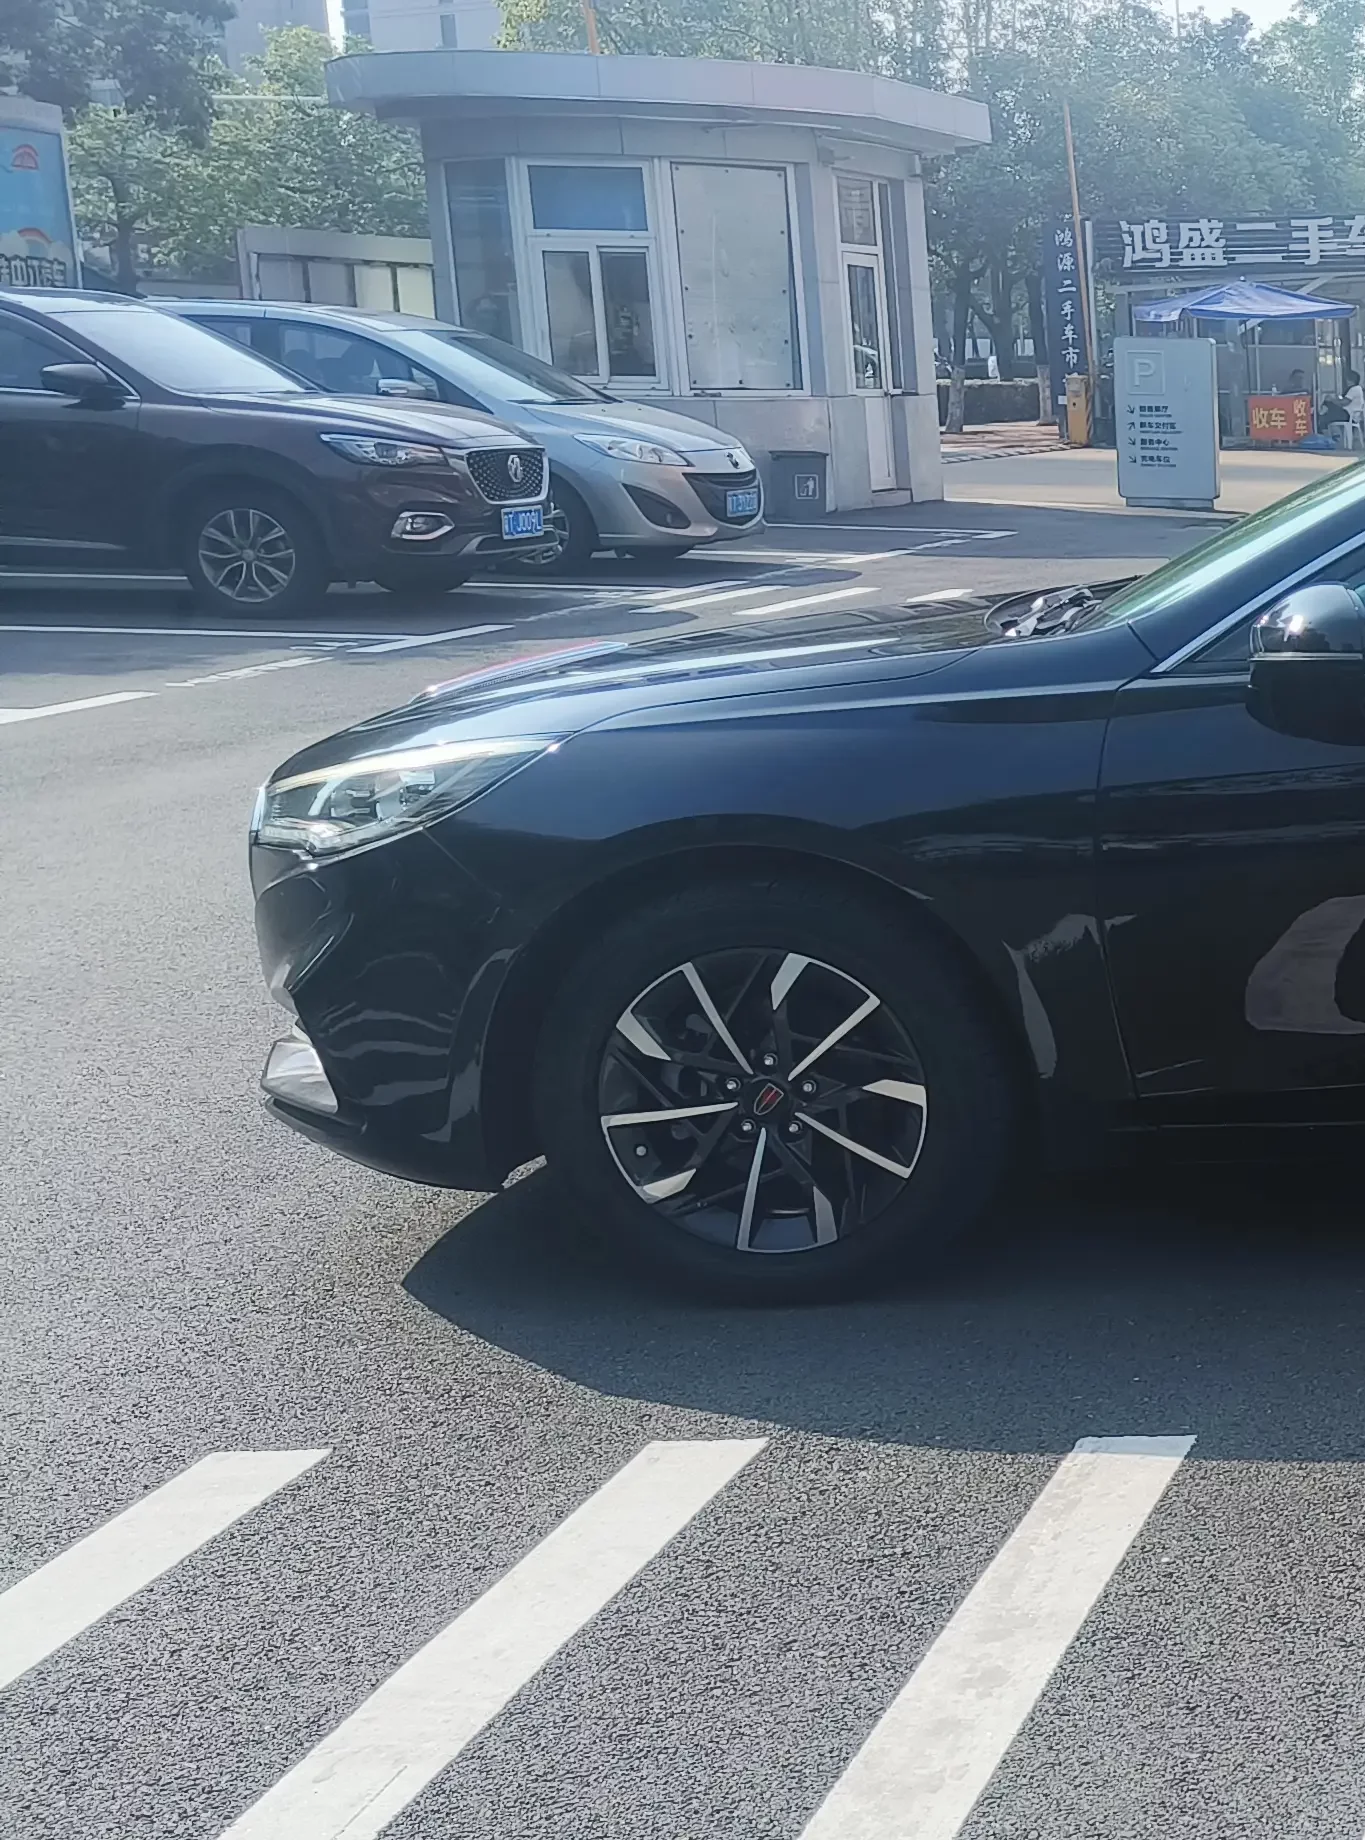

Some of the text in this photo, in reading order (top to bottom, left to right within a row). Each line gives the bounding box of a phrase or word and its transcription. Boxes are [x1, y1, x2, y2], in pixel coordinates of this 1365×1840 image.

[1054, 228, 1081, 388] 鸿源二手车市
[1133, 358, 1156, 387] P
[1252, 407, 1287, 429] 收车
[1293, 399, 1309, 437] 收车
